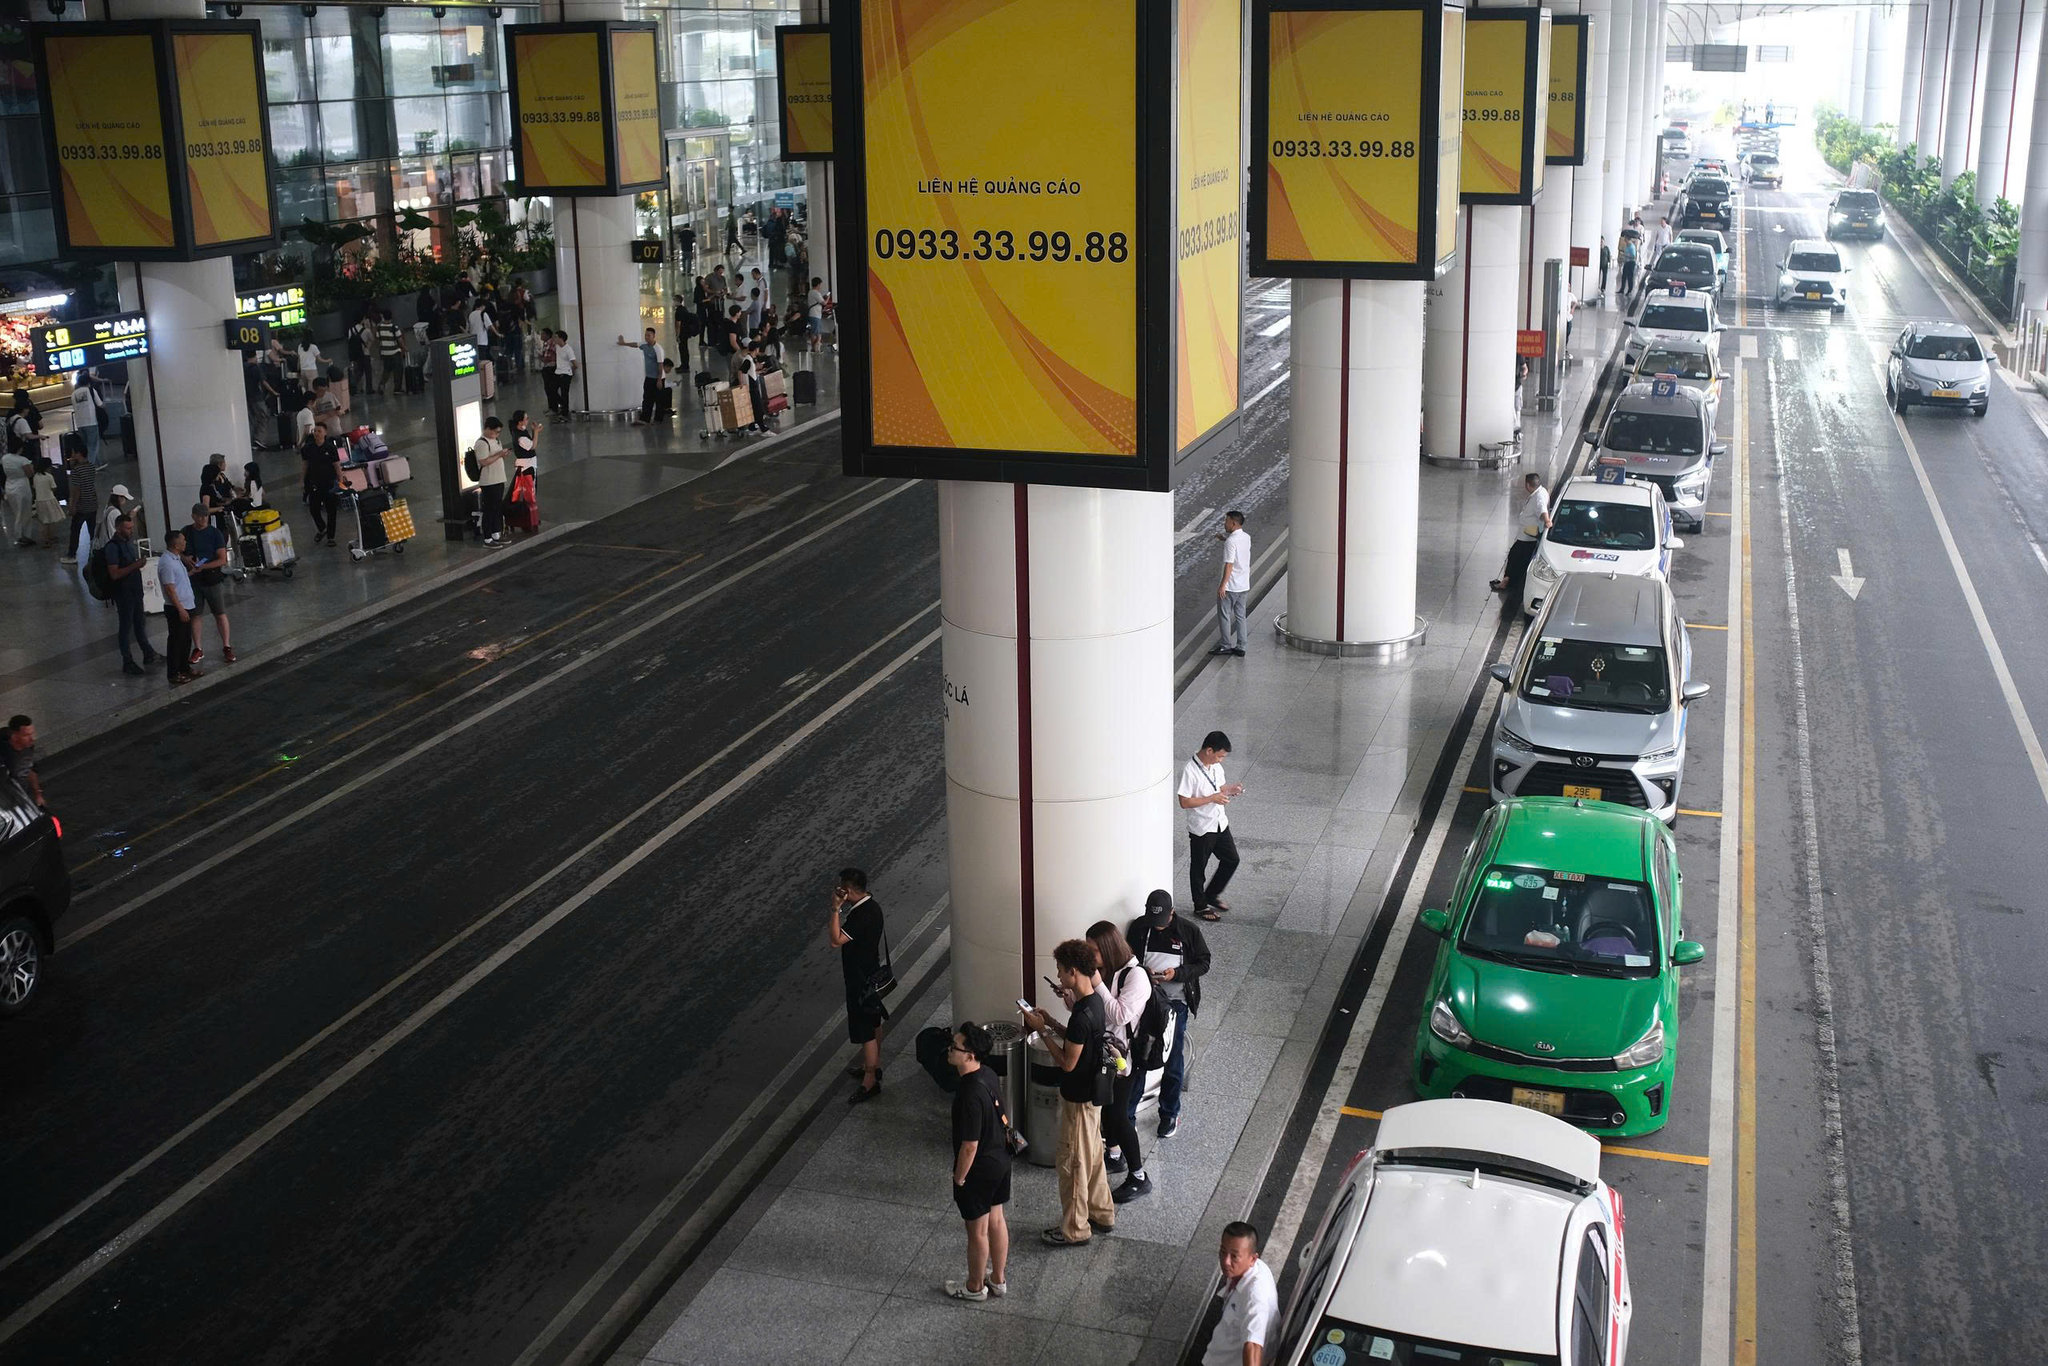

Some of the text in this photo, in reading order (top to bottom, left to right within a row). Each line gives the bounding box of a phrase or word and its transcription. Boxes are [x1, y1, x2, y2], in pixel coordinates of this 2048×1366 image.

[522, 111, 600, 123] 0933.33.99.88
[61, 145, 162, 159] 0933.33.99.88
[187, 139, 261, 158] 0933.33.99.88
[1272, 140, 1415, 158] 0933.33.99.88
[918, 176, 1081, 196] LIÊN HỆ QUẢNG CÁO
[1180, 210, 1237, 260] 0933.33.99.88
[643, 246, 659, 258] 07
[875, 229, 1128, 263] 0933.33.99.88
[243, 297, 257, 312] A2
[275, 291, 288, 306] A1
[113, 317, 146, 336] A3-A4
[240, 327, 260, 343] 08
[1593, 552, 1618, 561] TAXI
[955, 686, 969, 706] LÁ
[1574, 787, 1591, 796] 29E
[1486, 879, 1512, 889] TAXI
[1523, 880, 1538, 888] 635
[1554, 871, 1584, 882] XE TAXI
[1537, 1042, 1551, 1050] KIA
